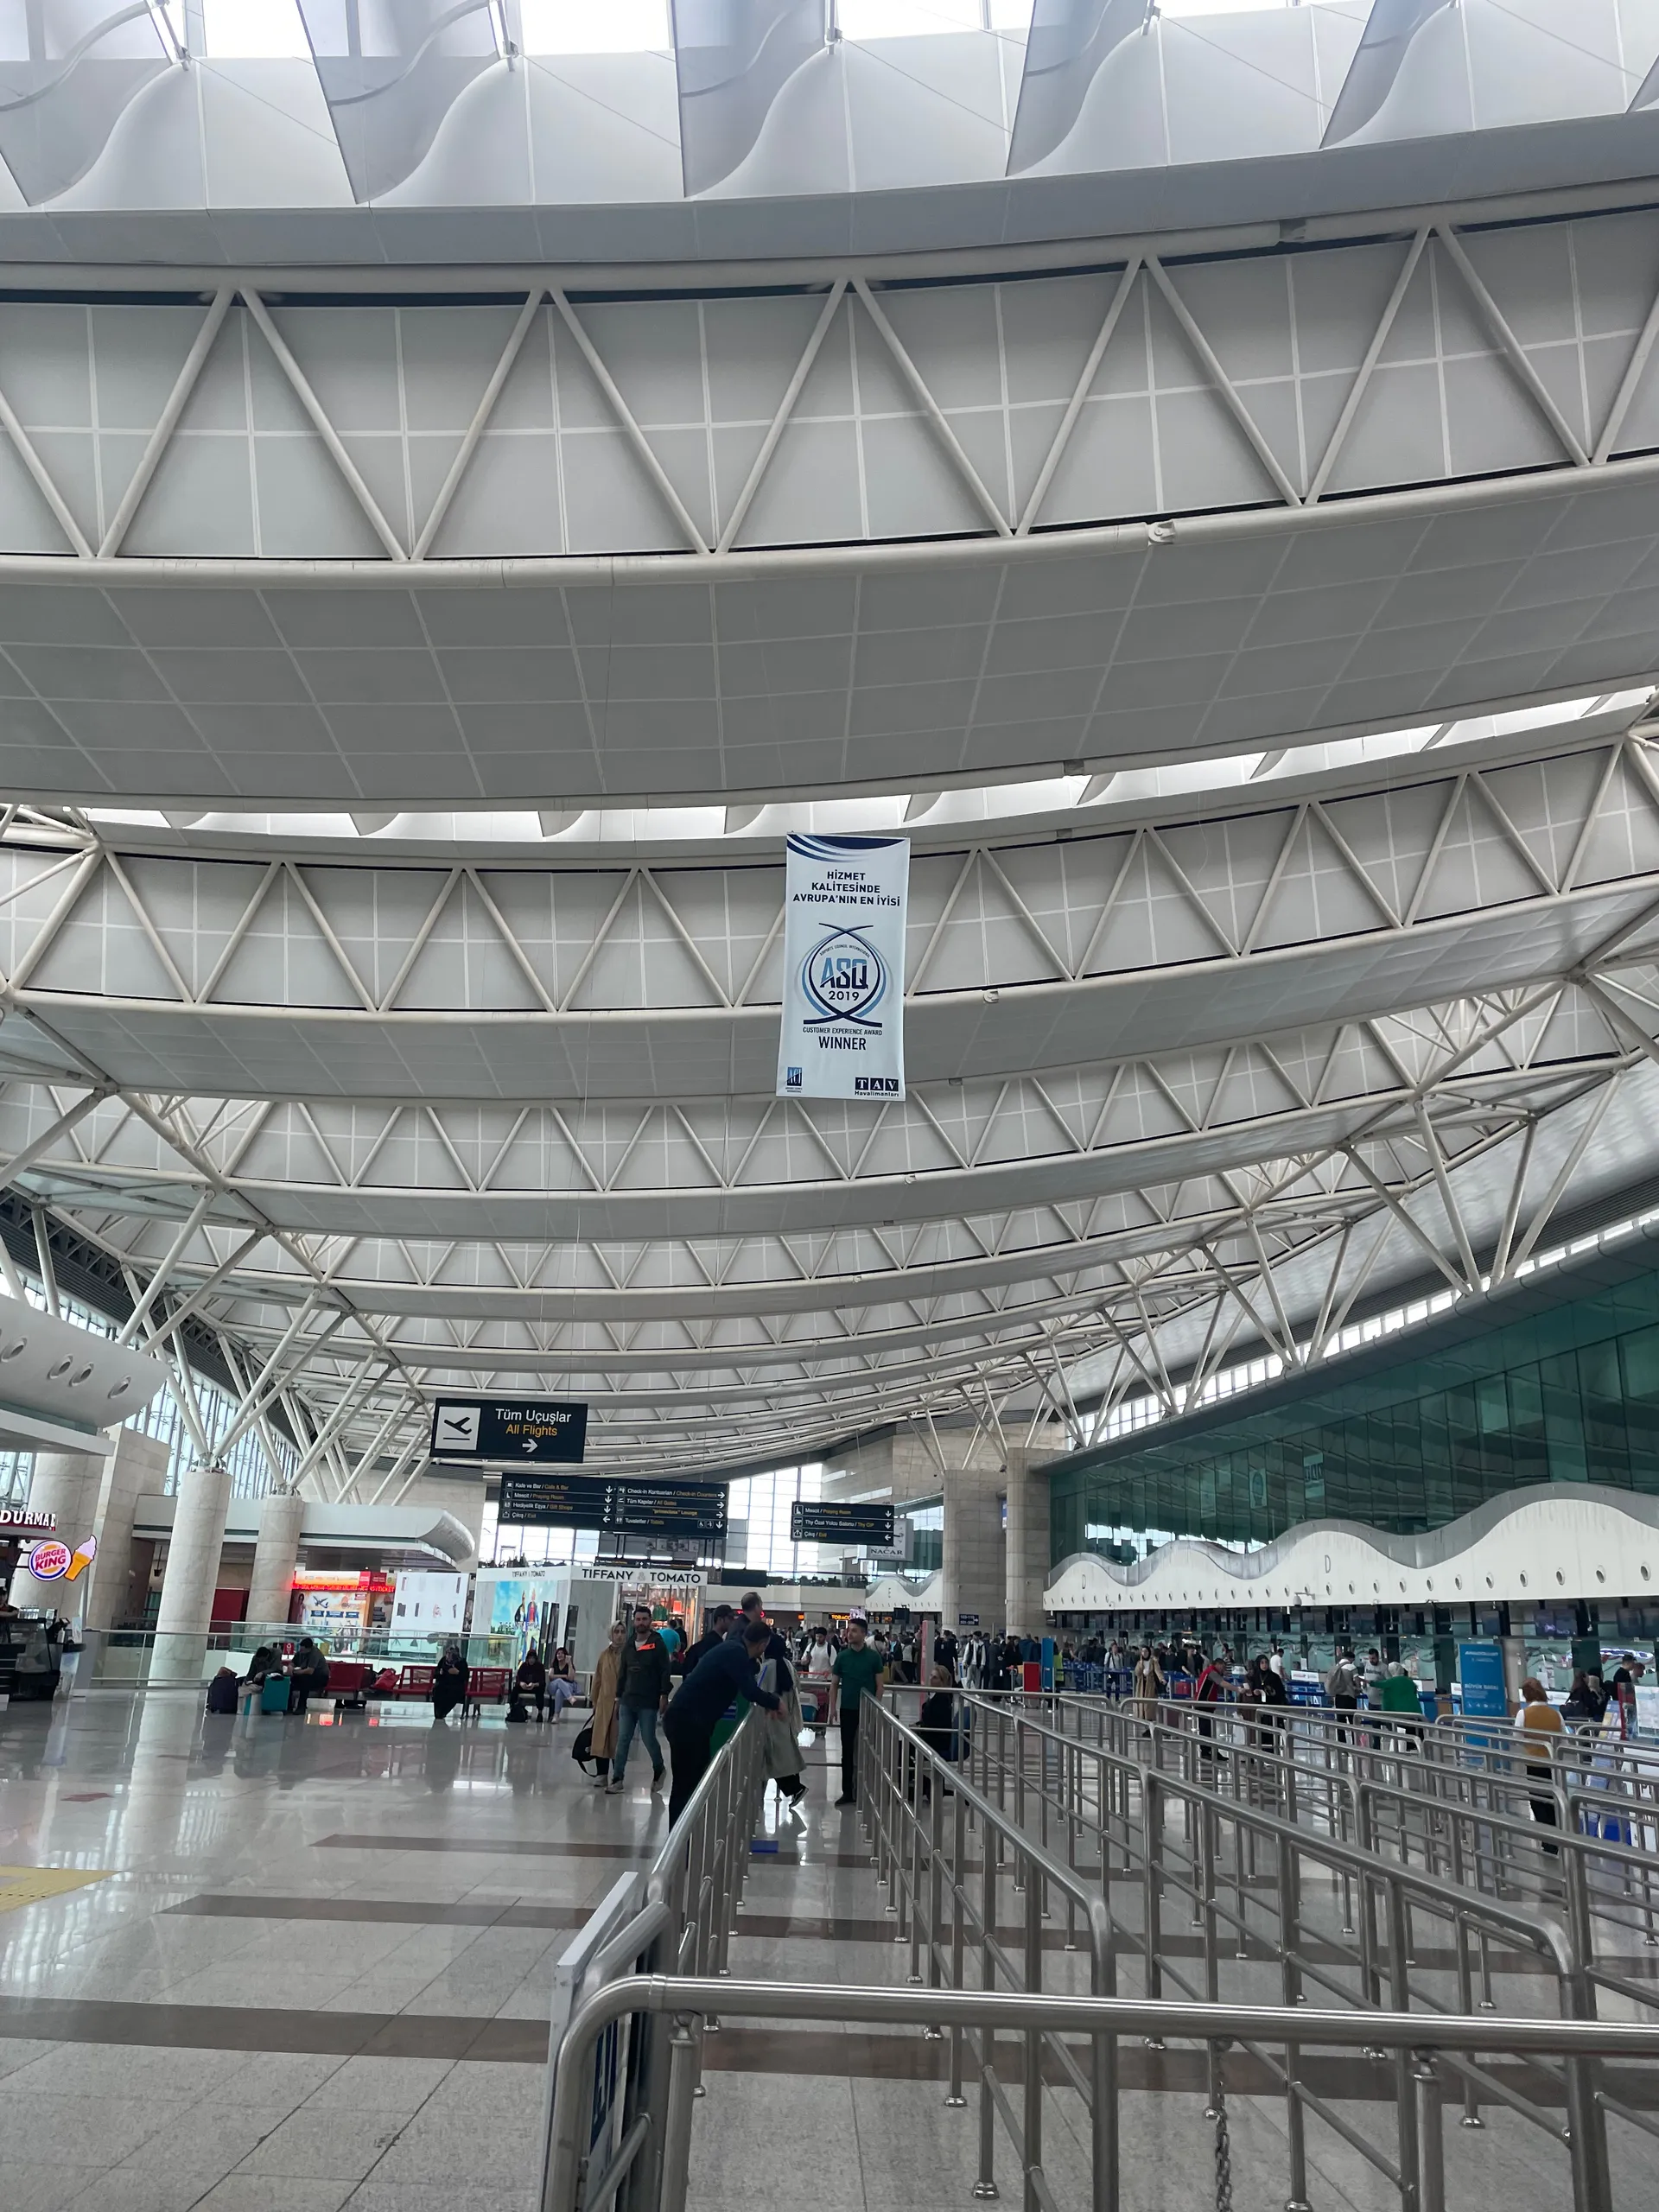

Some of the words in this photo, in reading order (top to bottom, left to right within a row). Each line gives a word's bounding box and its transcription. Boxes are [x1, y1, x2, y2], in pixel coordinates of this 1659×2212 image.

[827, 869, 866, 880] HİZMET
[811, 881, 880, 893] KALİTESİNDE
[792, 893, 857, 904] AVRUPA'NIN
[860, 896, 874, 905] EN
[877, 895, 900, 906] İYİSİ
[819, 957, 869, 989] ASQ
[828, 990, 860, 1001] 2019
[818, 1036, 867, 1050] WINNER
[495, 1408, 522, 1421] Tüm
[525, 1409, 572, 1425] Uçuşlar
[505, 1424, 519, 1434] All
[522, 1424, 558, 1437] Flights
[35, 1548, 66, 1560] BURGER
[35, 1555, 67, 1571] KING
[1325, 1554, 1332, 1573] D
[582, 1569, 633, 1580] TIFFANY
[650, 1573, 701, 1583] TOMATO
